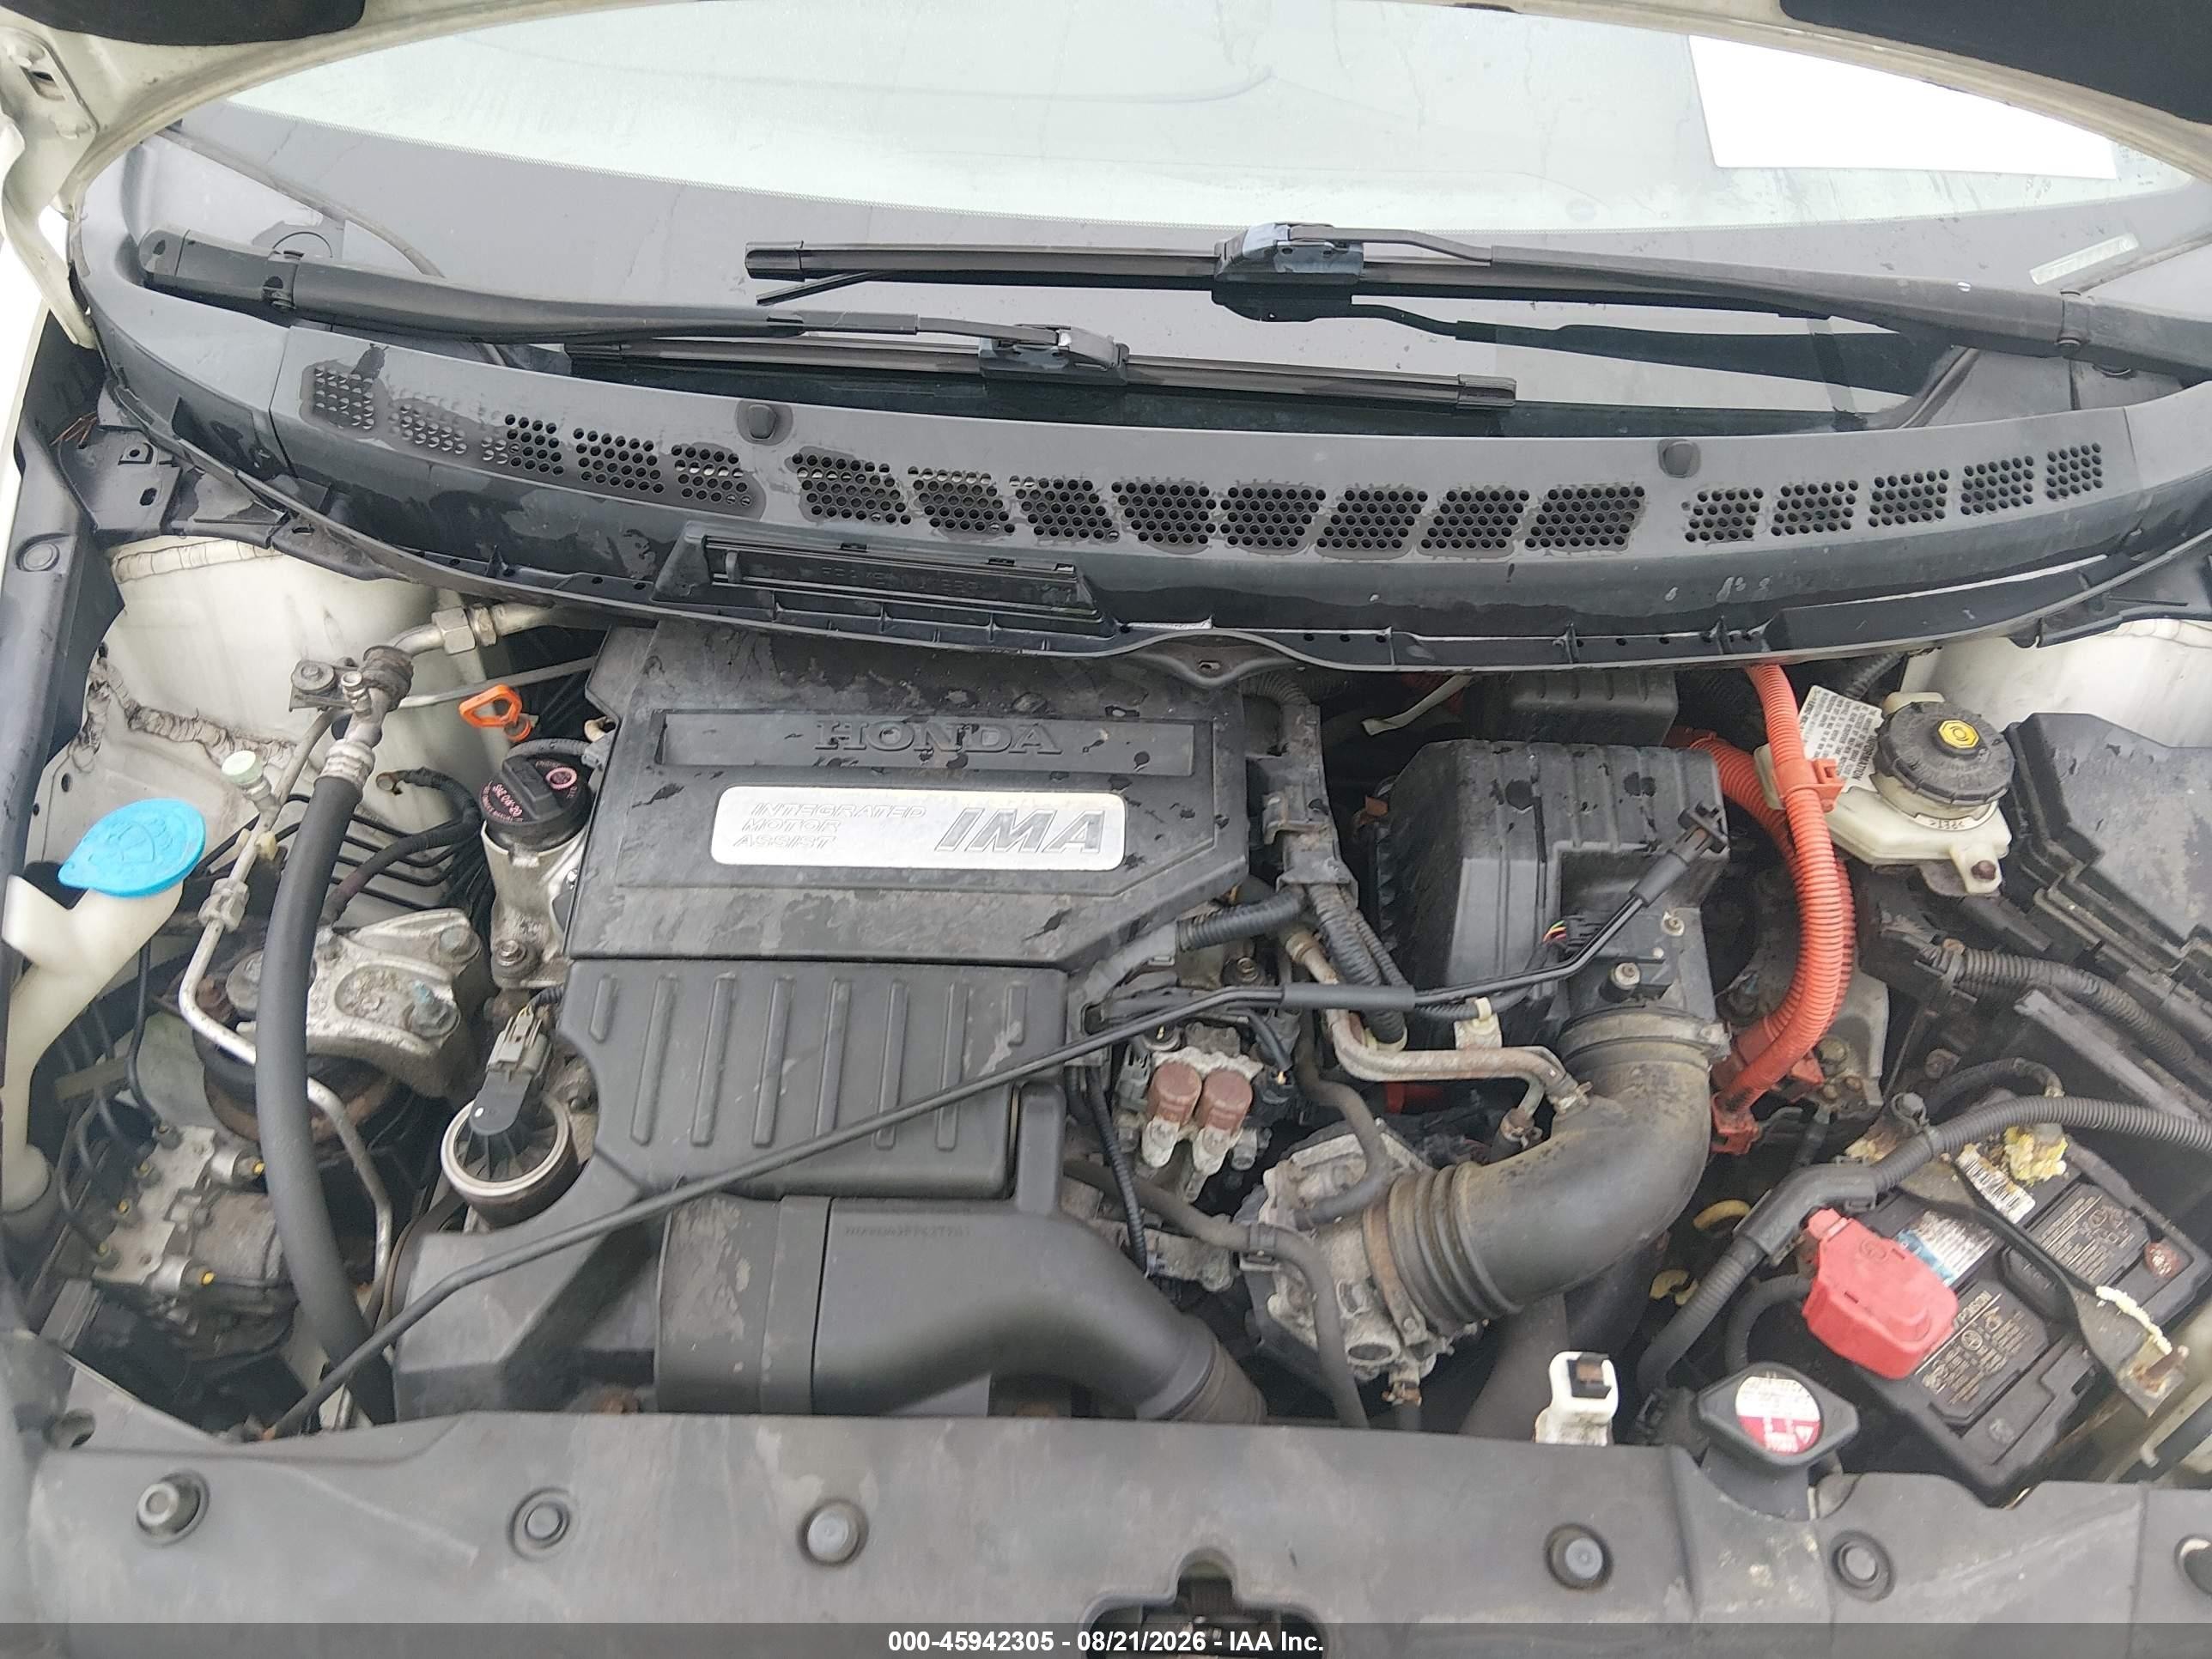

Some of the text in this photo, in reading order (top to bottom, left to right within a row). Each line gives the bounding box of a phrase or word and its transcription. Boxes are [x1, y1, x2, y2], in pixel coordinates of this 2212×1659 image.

[814, 720, 1062, 754] HONDA
[752, 803, 927, 818] INTEGRATED
[742, 817, 842, 832] MOTOR
[935, 805, 1106, 854] IMA
[733, 835, 838, 848] ASSIST
